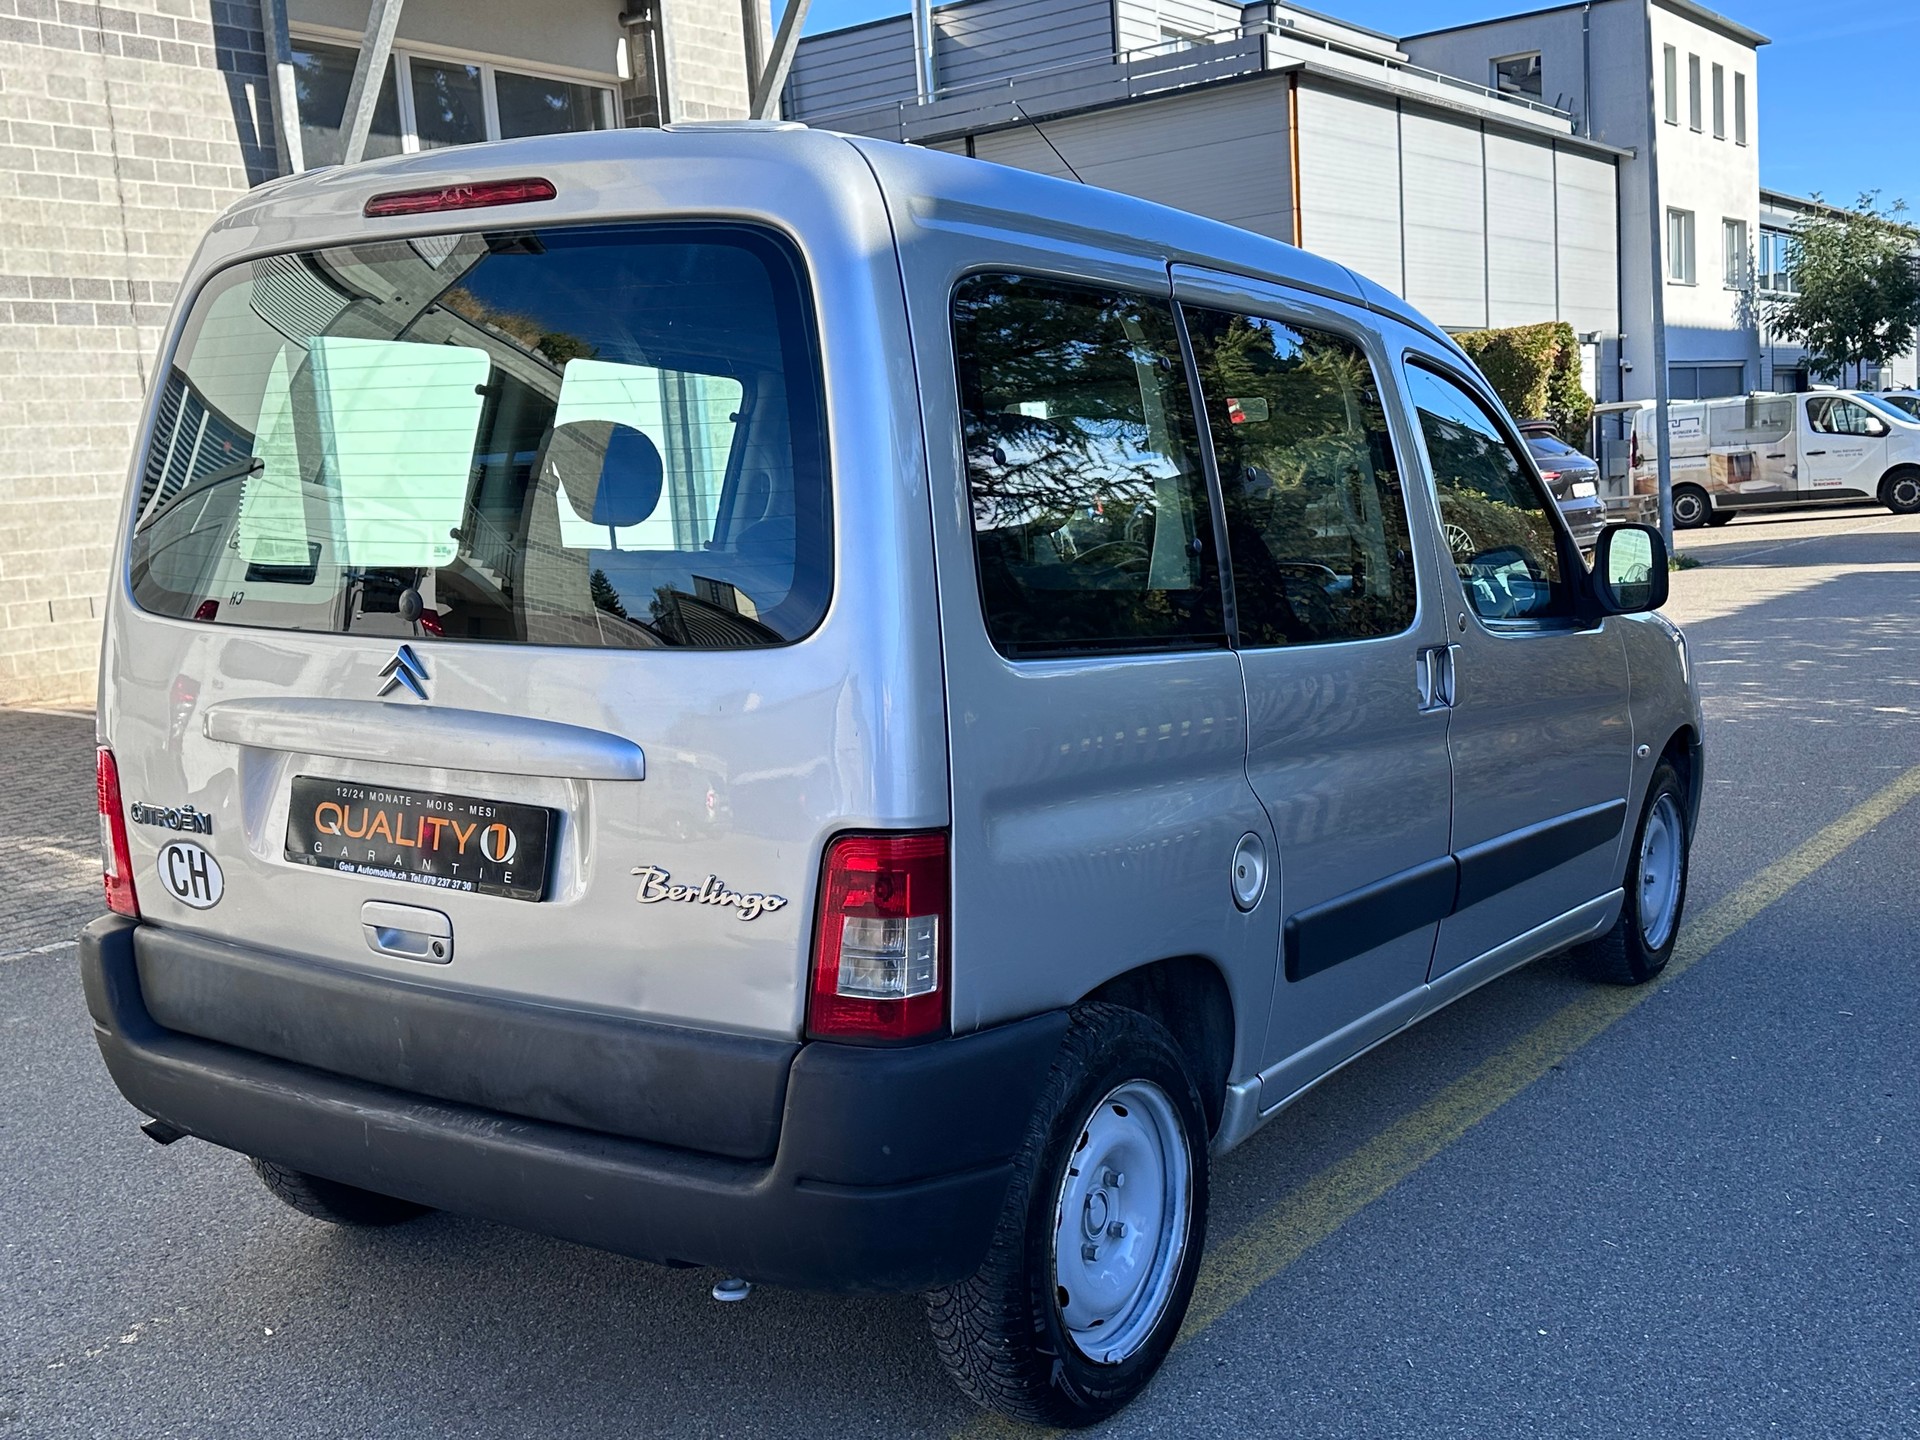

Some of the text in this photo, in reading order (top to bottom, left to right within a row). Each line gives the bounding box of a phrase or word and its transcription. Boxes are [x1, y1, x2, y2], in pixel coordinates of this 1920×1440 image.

[131, 801, 213, 835] CITROËN
[336, 787, 364, 800] 12/24
[369, 791, 411, 806] MONATE
[426, 800, 454, 812] MOIS
[469, 805, 496, 817] MESI
[314, 801, 478, 855] QUALITY
[168, 846, 211, 901] CH
[314, 842, 512, 883] GARANTIE
[356, 864, 407, 880] Automobile.ch
[437, 877, 451, 887] 237
[452, 880, 461, 889] 37
[462, 881, 471, 891] 30
[630, 865, 788, 921] Berlingo
